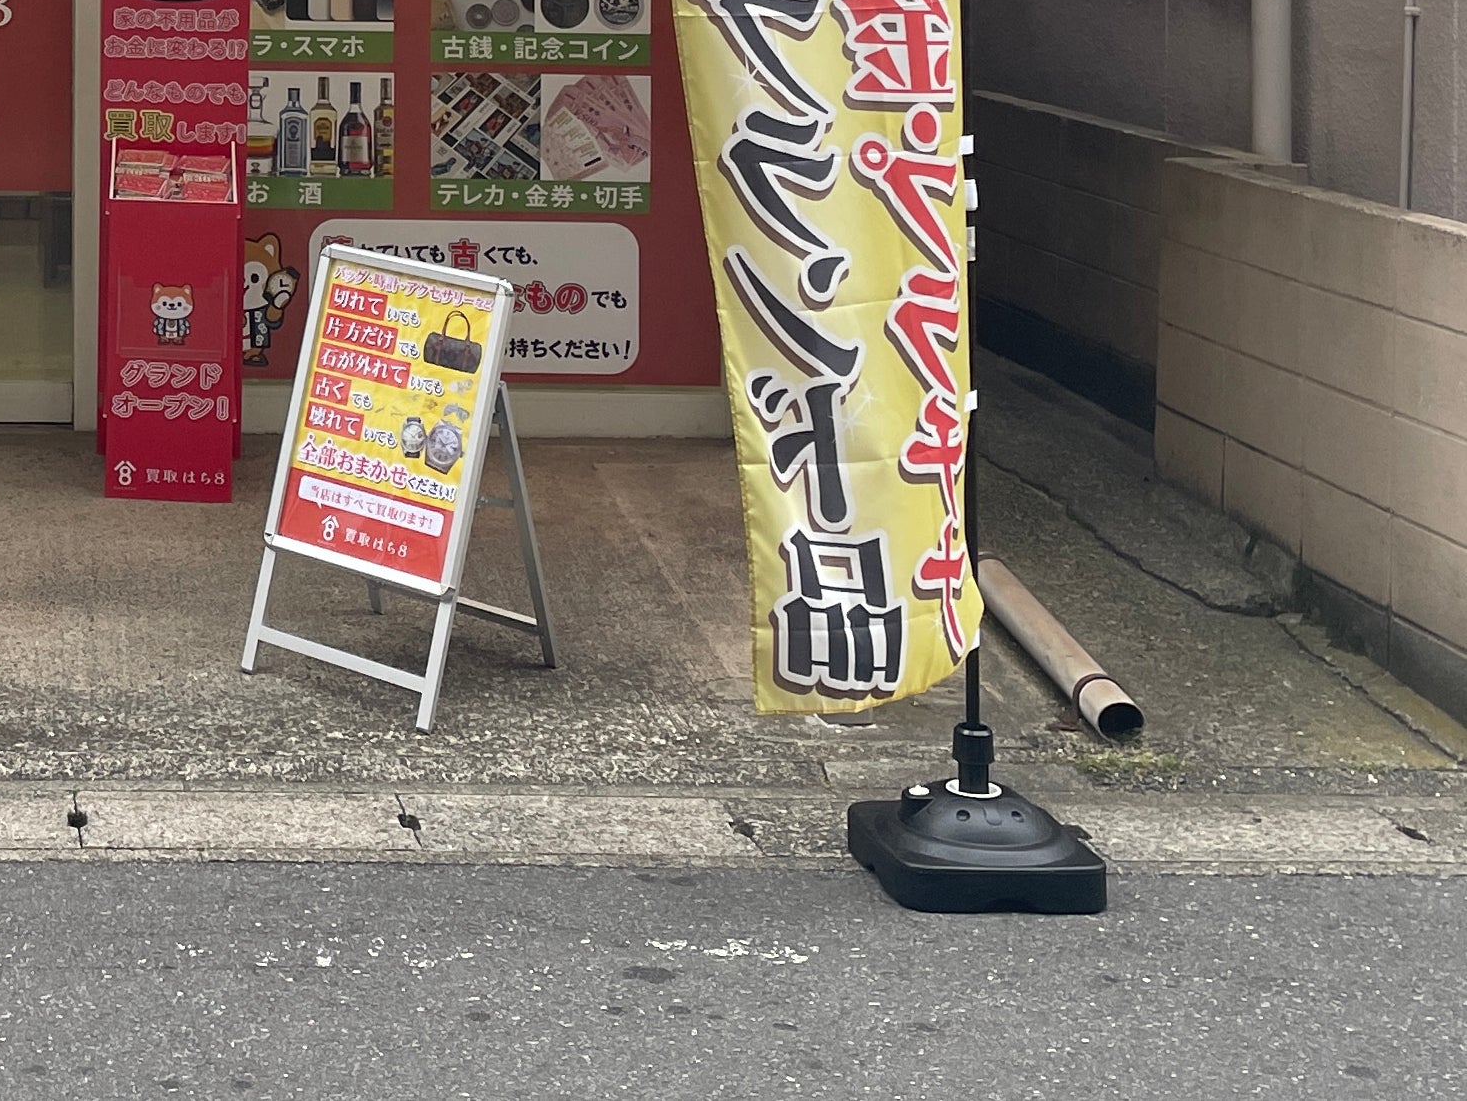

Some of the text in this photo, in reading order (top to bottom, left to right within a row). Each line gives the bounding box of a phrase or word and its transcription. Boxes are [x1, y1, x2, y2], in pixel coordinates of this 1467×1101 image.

[113, 6, 240, 31] 家の不用品が
[442, 36, 640, 60] 古銭・記念コイン
[104, 79, 247, 105] どんなものでも
[437, 184, 643, 209] テレカ・金券・切手
[505, 338, 631, 360] 持ちください!
[120, 359, 222, 390] グランド
[111, 391, 229, 420] オープン!
[146, 468, 225, 485] 買取はち8
